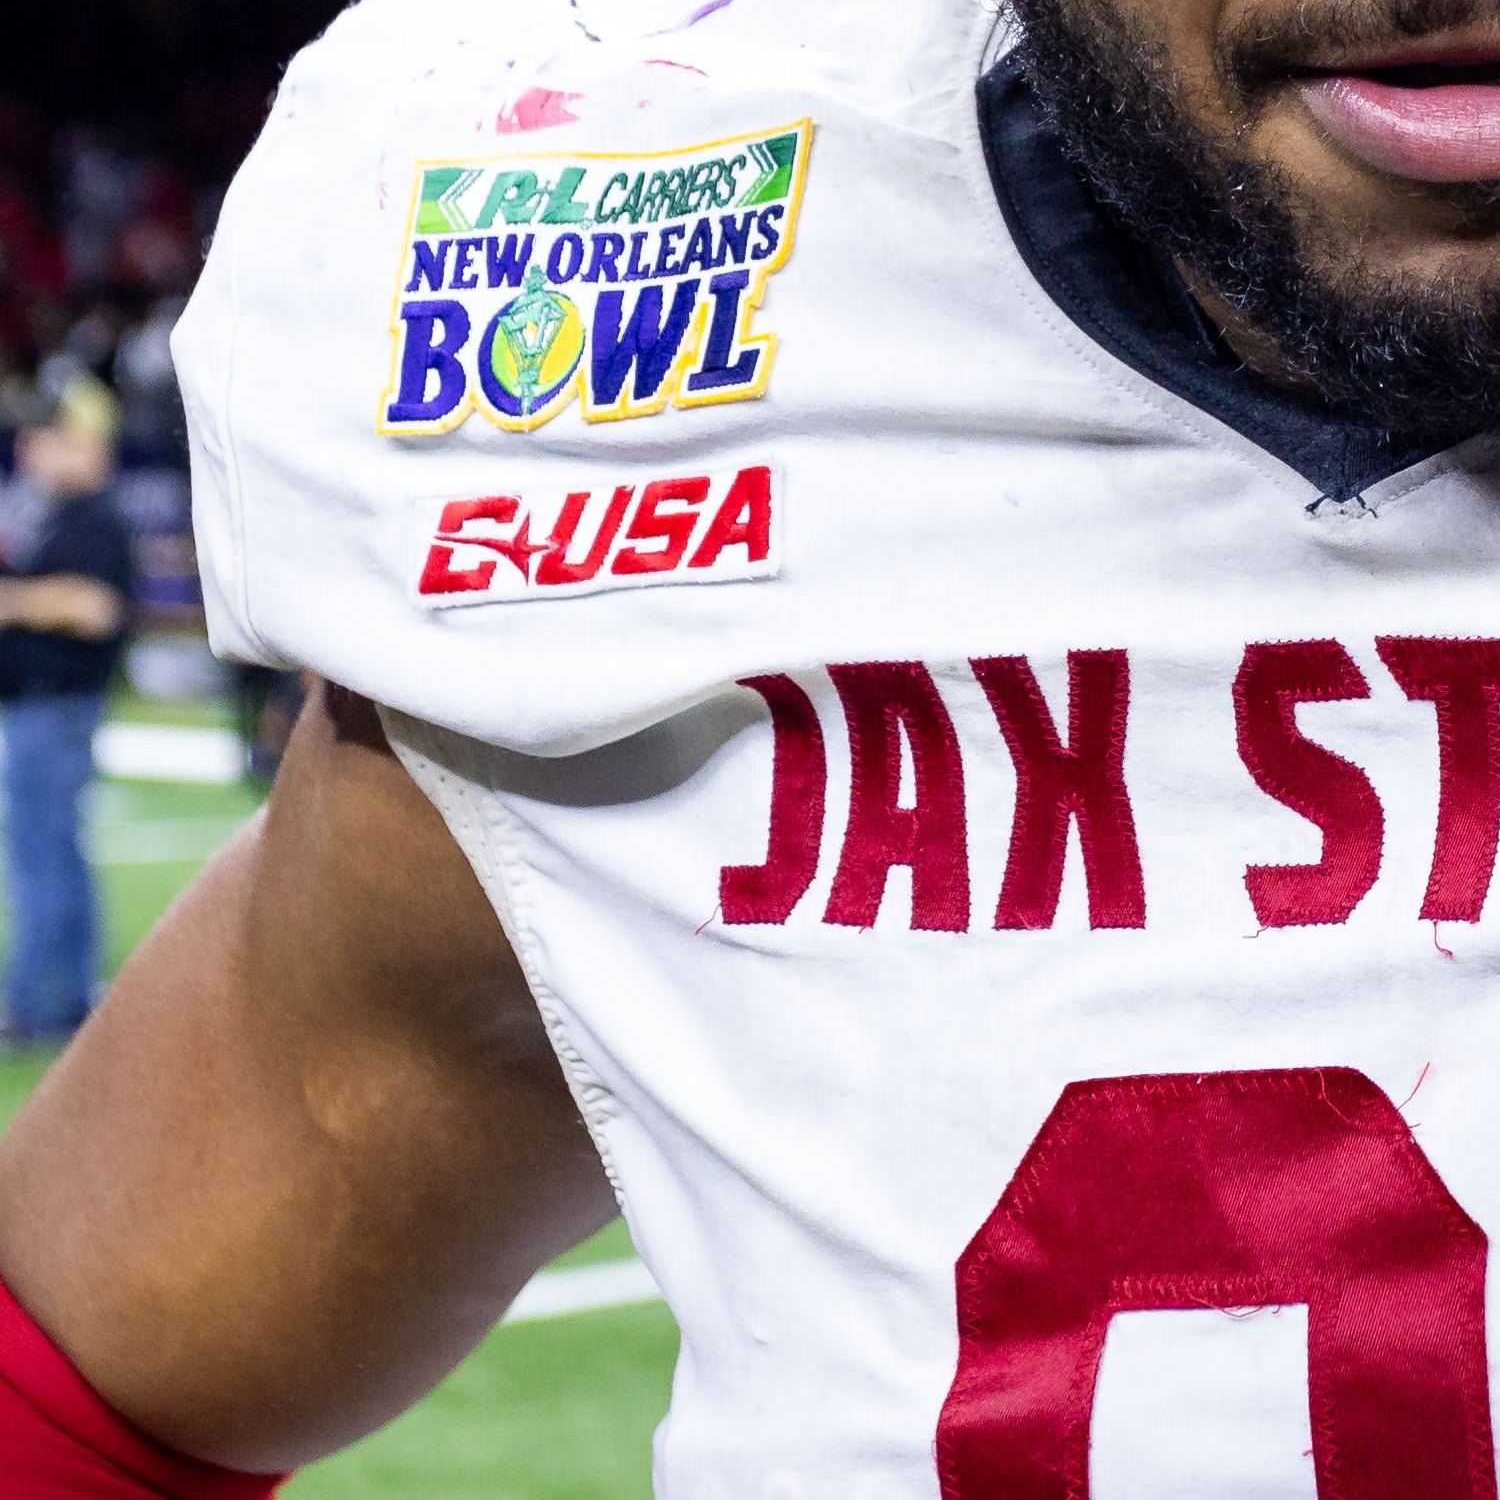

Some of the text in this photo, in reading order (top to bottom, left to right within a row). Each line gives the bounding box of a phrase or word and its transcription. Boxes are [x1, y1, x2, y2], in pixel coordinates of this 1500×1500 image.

[404, 204, 786, 292] NEW ORLEANS
[594, 153, 748, 224] CARRIERS
[386, 268, 761, 423] BOWL
[719, 648, 1147, 934] JAX
